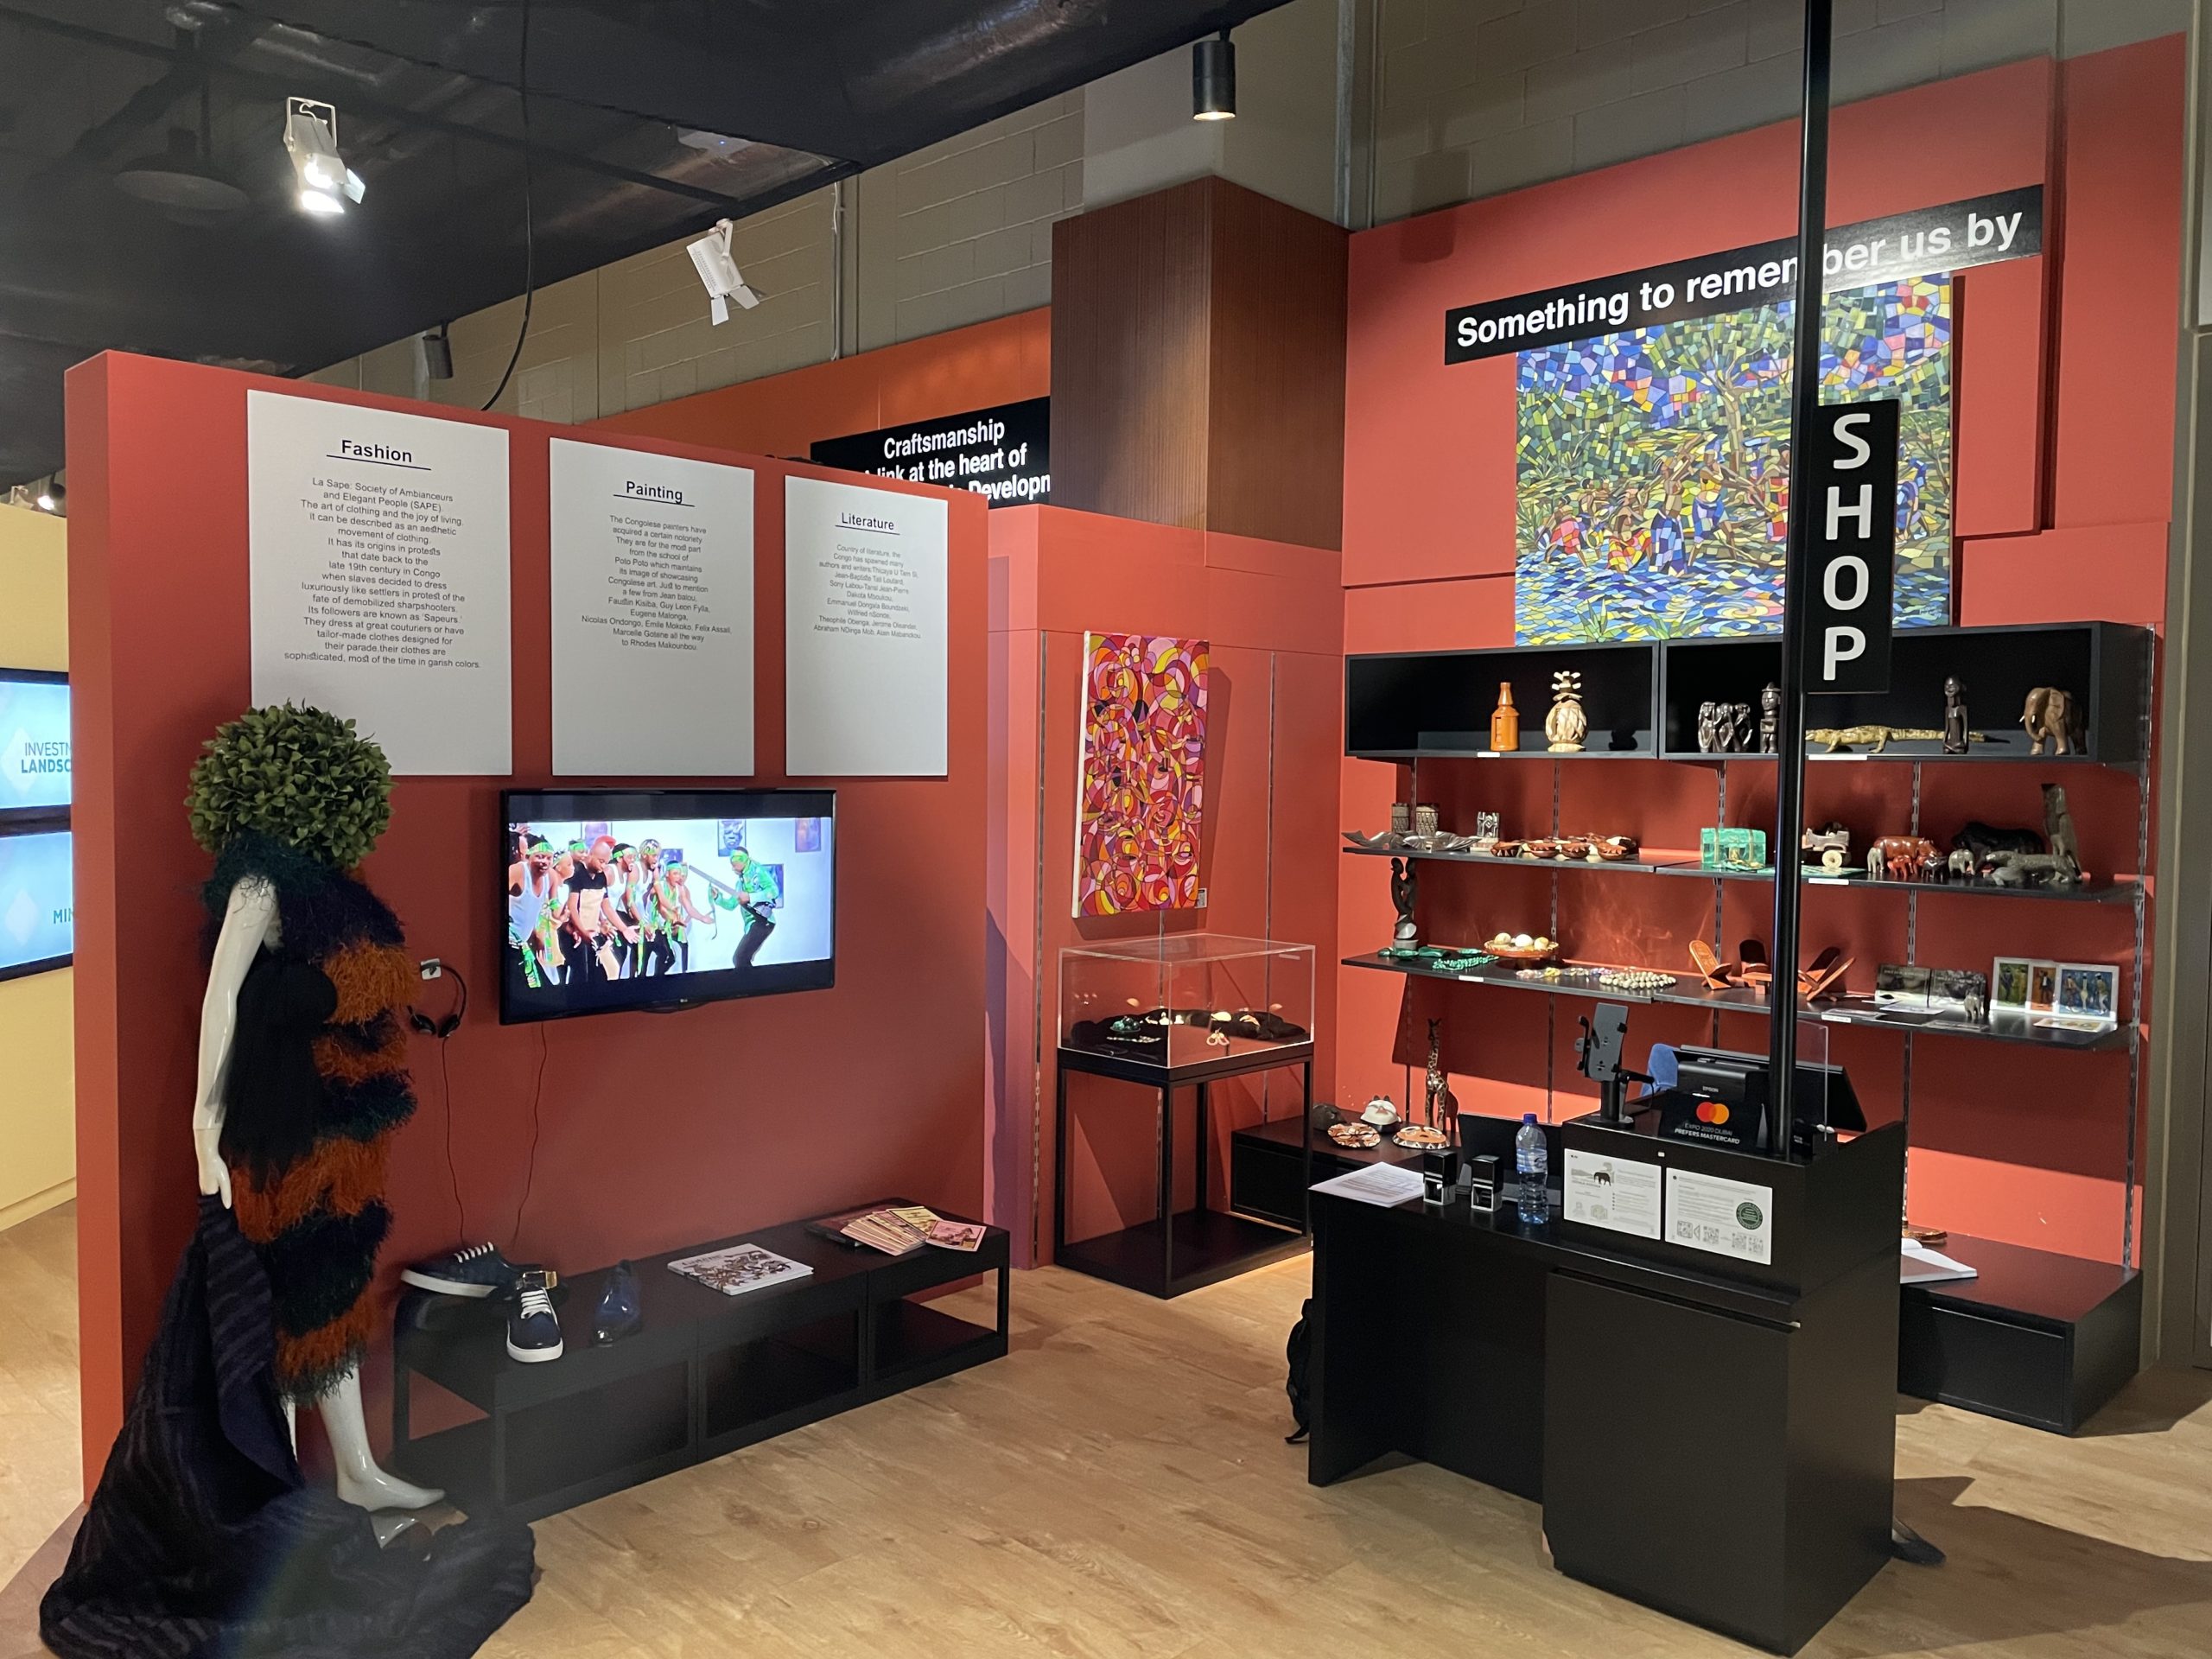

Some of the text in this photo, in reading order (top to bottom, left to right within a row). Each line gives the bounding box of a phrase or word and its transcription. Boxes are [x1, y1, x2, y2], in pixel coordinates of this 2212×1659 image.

[1457, 291, 1629, 347] Something
[1639, 282, 1675, 311] to
[1901, 226, 1951, 259] us
[1967, 212, 2023, 252] by
[883, 418, 1005, 460] Craftsmanship
[341, 439, 412, 463] Fashion
[909, 461, 925, 482] at
[928, 458, 955, 480] the
[959, 448, 1004, 475] heart
[1007, 442, 1027, 467] of
[312, 478, 323, 486] La
[354, 483, 386, 496] Society
[399, 488, 453, 502] Ambianceurs
[626, 480, 683, 505] Painting
[323, 492, 340, 500] and
[342, 493, 375, 505] Elegant
[378, 497, 408, 509] People
[301, 499, 318, 509] The
[346, 505, 379, 518] clothing
[382, 510, 397, 518] and
[400, 511, 414, 520] the
[416, 512, 428, 524] joy
[336, 515, 347, 524] be
[350, 517, 391, 529] described
[420, 525, 455, 536] aesthetic
[610, 515, 706, 534] The Congolese painters have
[842, 512, 894, 530] Literature
[338, 528, 383, 539] movement
[613, 527, 642, 536] acquired
[336, 537, 352, 547] has
[354, 540, 365, 549] its
[367, 542, 395, 552] origins
[408, 547, 440, 556] protests
[616, 536, 632, 547] They
[647, 539, 657, 548] for
[1823, 412, 1872, 681] SHOP
[341, 550, 358, 559] that
[360, 551, 379, 562] date
[382, 554, 402, 563] back
[415, 557, 428, 566] the
[629, 548, 645, 556] from
[658, 551, 680, 560] school
[833, 553, 851, 563] Congo
[328, 560, 440, 579] late 19th century in Congo
[671, 563, 702, 572] maintains
[321, 572, 346, 581] when
[348, 574, 375, 583] slaves
[378, 576, 411, 587] decided
[424, 580, 446, 589] dress
[608, 576, 645, 587] Congolese
[659, 581, 672, 589] Just
[629, 568, 650, 578] image
[660, 571, 697, 583] showcasing
[302, 582, 348, 594] luxuriously
[351, 585, 366, 594] like
[369, 588, 399, 596] settlers
[629, 588, 676, 600] few from Jean
[313, 594, 329, 603] fate
[343, 596, 394, 607] demobilized
[659, 601, 673, 611] Guy
[321, 606, 360, 616] followers
[379, 610, 407, 620] known
[582, 615, 607, 624] Nicolas
[630, 608, 656, 619] Eugene
[304, 617, 326, 627] They
[328, 618, 353, 627] dress
[365, 622, 388, 631] great
[391, 624, 431, 632] couturiers
[444, 626, 464, 634] have
[317, 629, 366, 639] tailor-made
[369, 632, 399, 641] clothes
[402, 634, 439, 645] designed
[630, 639, 656, 647] Rhodes
[325, 641, 344, 650] their
[400, 645, 429, 654] clothes
[428, 658, 453, 667] garish
[1675, 1128, 1740, 1145] PREFERS MASTERCARD
[1685, 1122, 1700, 1131] EXPO
[1714, 1128, 1732, 1136] DUBAI
